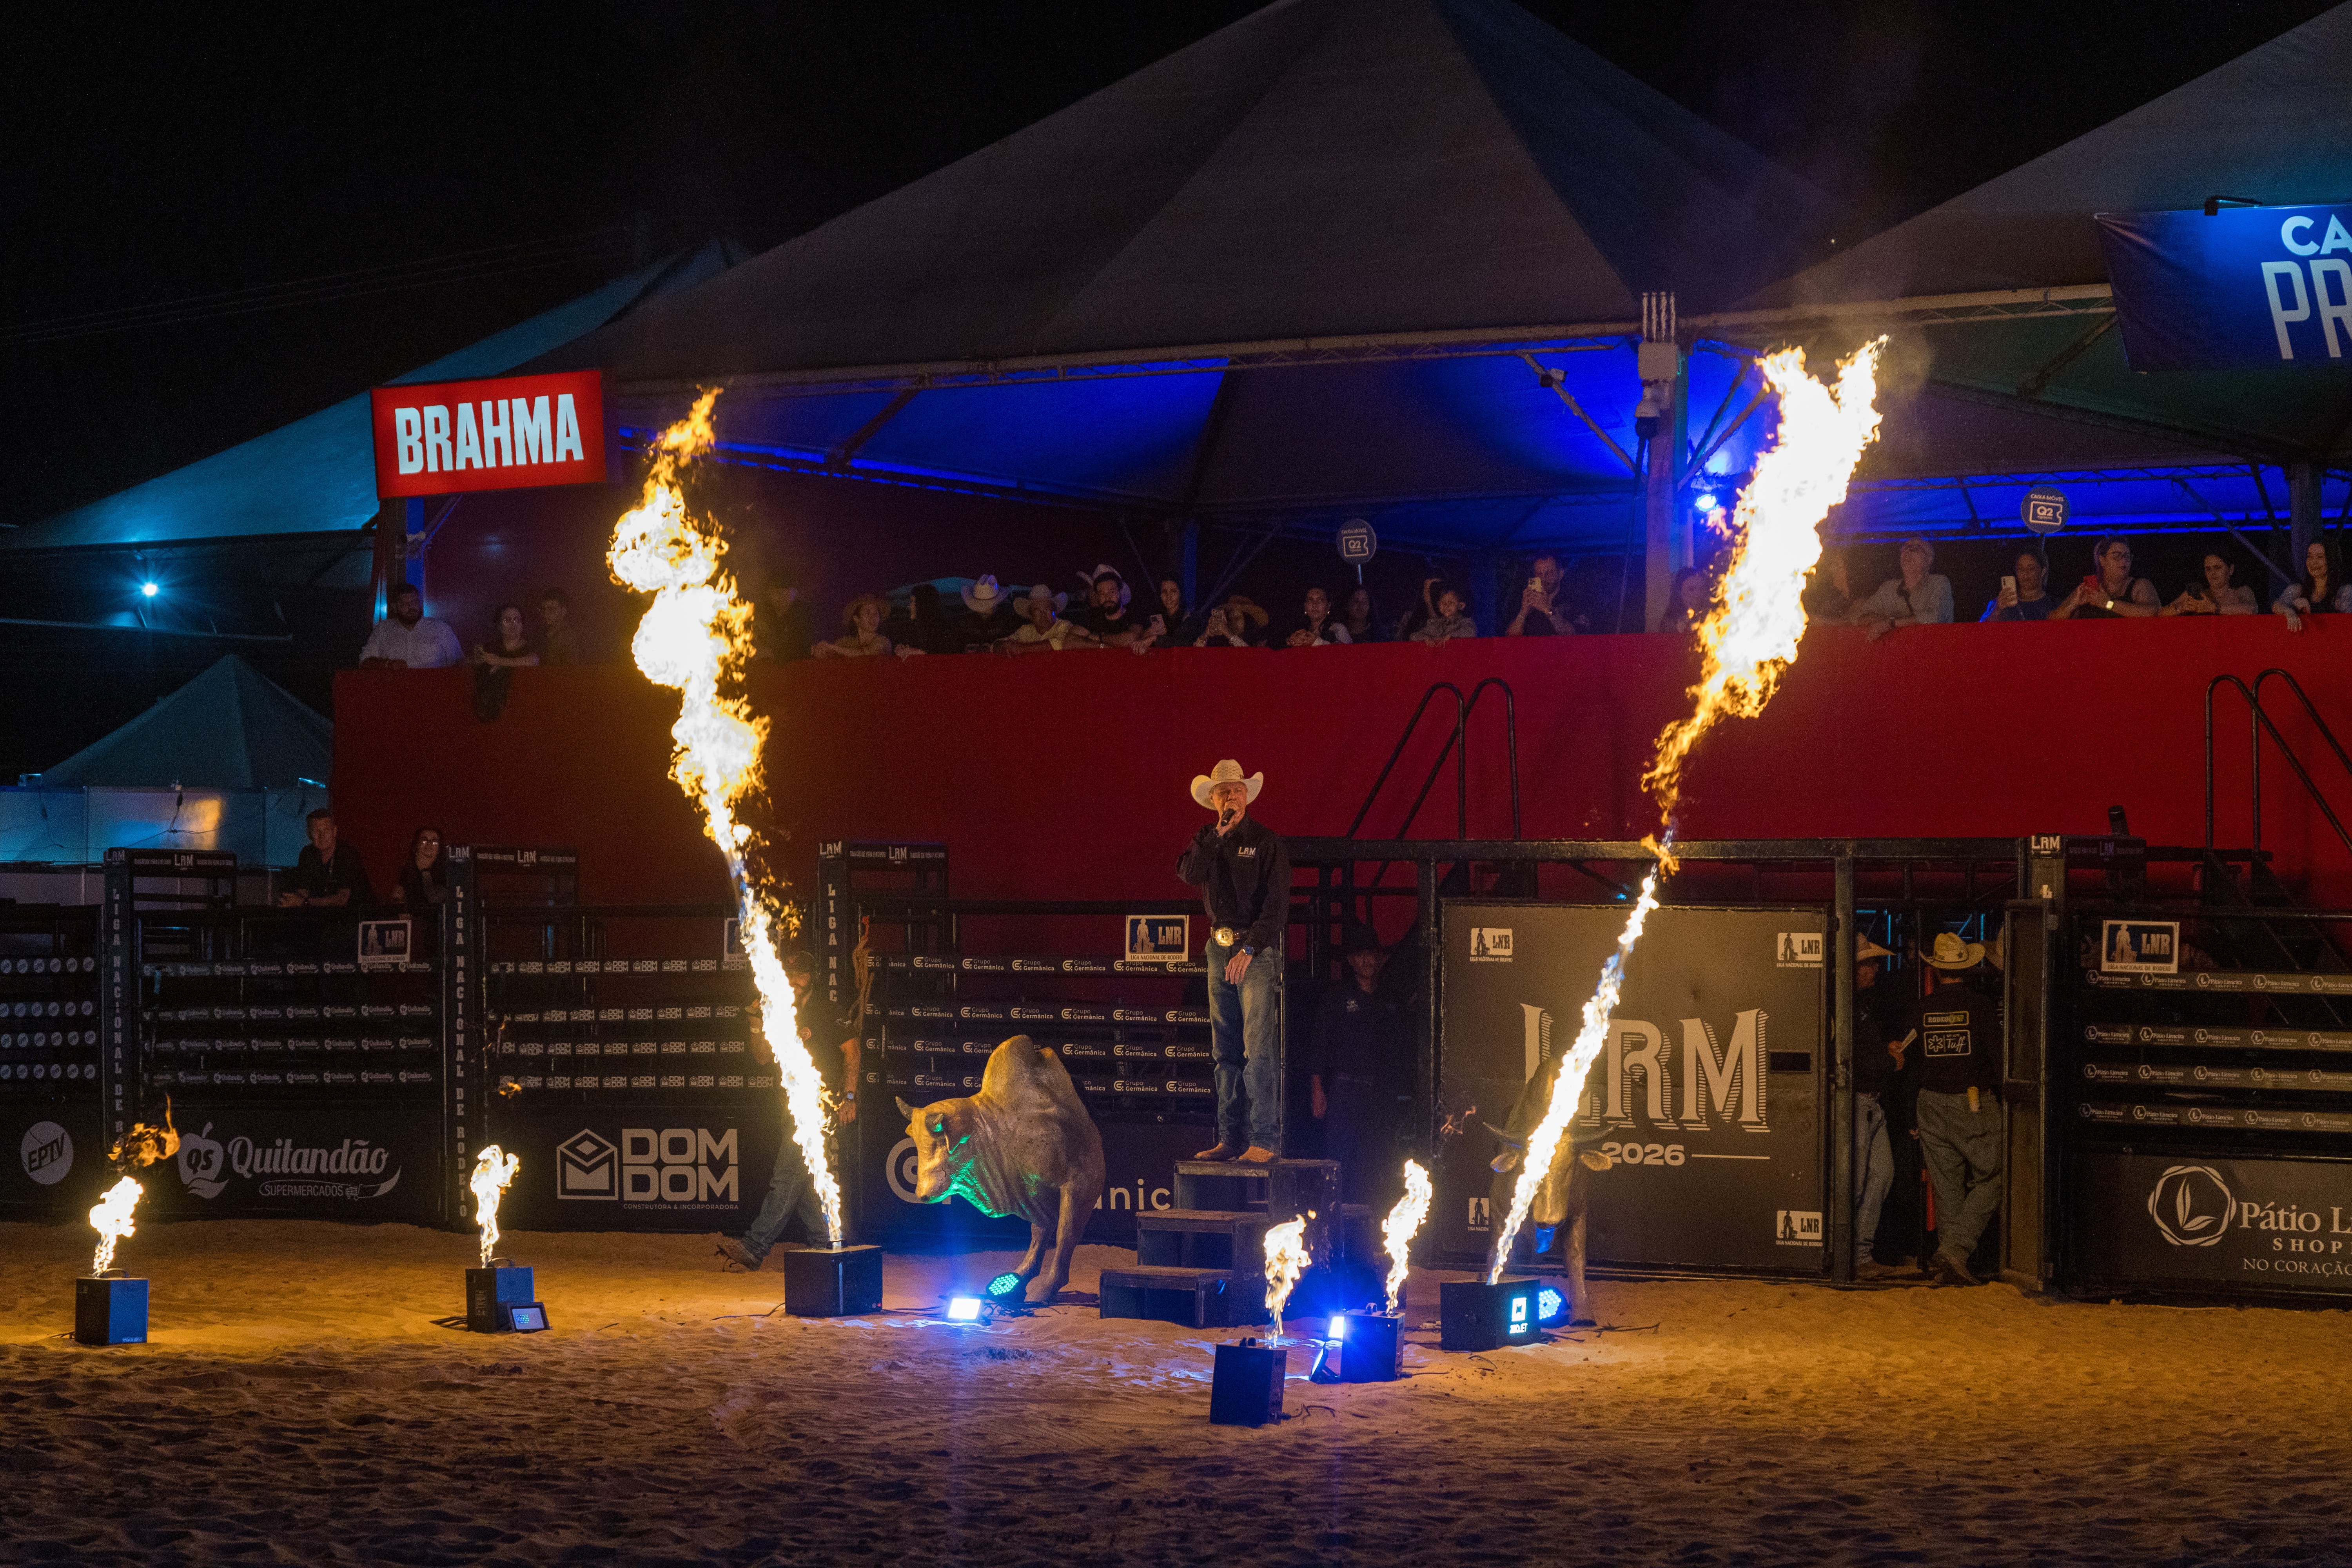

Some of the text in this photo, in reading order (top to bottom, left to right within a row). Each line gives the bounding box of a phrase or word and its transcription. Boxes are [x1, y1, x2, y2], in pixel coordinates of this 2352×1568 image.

[395, 393, 584, 475] BRAHMA
[2037, 506, 2053, 516] Q2
[1348, 540, 1361, 549] Q2
[819, 841, 842, 855] LRM
[1238, 846, 1257, 856] LRM
[2031, 835, 2061, 849] LRM
[174, 854, 193, 866] LRM
[448, 846, 469, 858] LRM
[517, 850, 536, 863] LRM
[889, 846, 907, 860] LRM
[828, 883, 837, 946] LIGA
[1158, 926, 1182, 945] LNR
[1493, 935, 1510, 949] LNR
[2141, 933, 2171, 955] LNR
[1801, 940, 1820, 954] LNR
[113, 955, 122, 1074] NACIONAL
[456, 886, 467, 1217] LIGA NACIONAL DE RODEIO
[1945, 1035, 1967, 1053] Tuff
[27, 1132, 65, 1174] EPTV
[622, 1128, 738, 1164] DOM
[1601, 1142, 1685, 1166] 2026
[186, 1148, 213, 1175] QS
[227, 1136, 389, 1178] Quitandão
[263, 1184, 343, 1197] SUPERMERCADOS
[622, 1165, 739, 1202] DOM
[1800, 1218, 1819, 1233] LNR
[2239, 1201, 2321, 1232] Pátio
[2273, 1238, 2352, 1254] SHOP
[2243, 1258, 2352, 1278] NO CORAÇÃO
